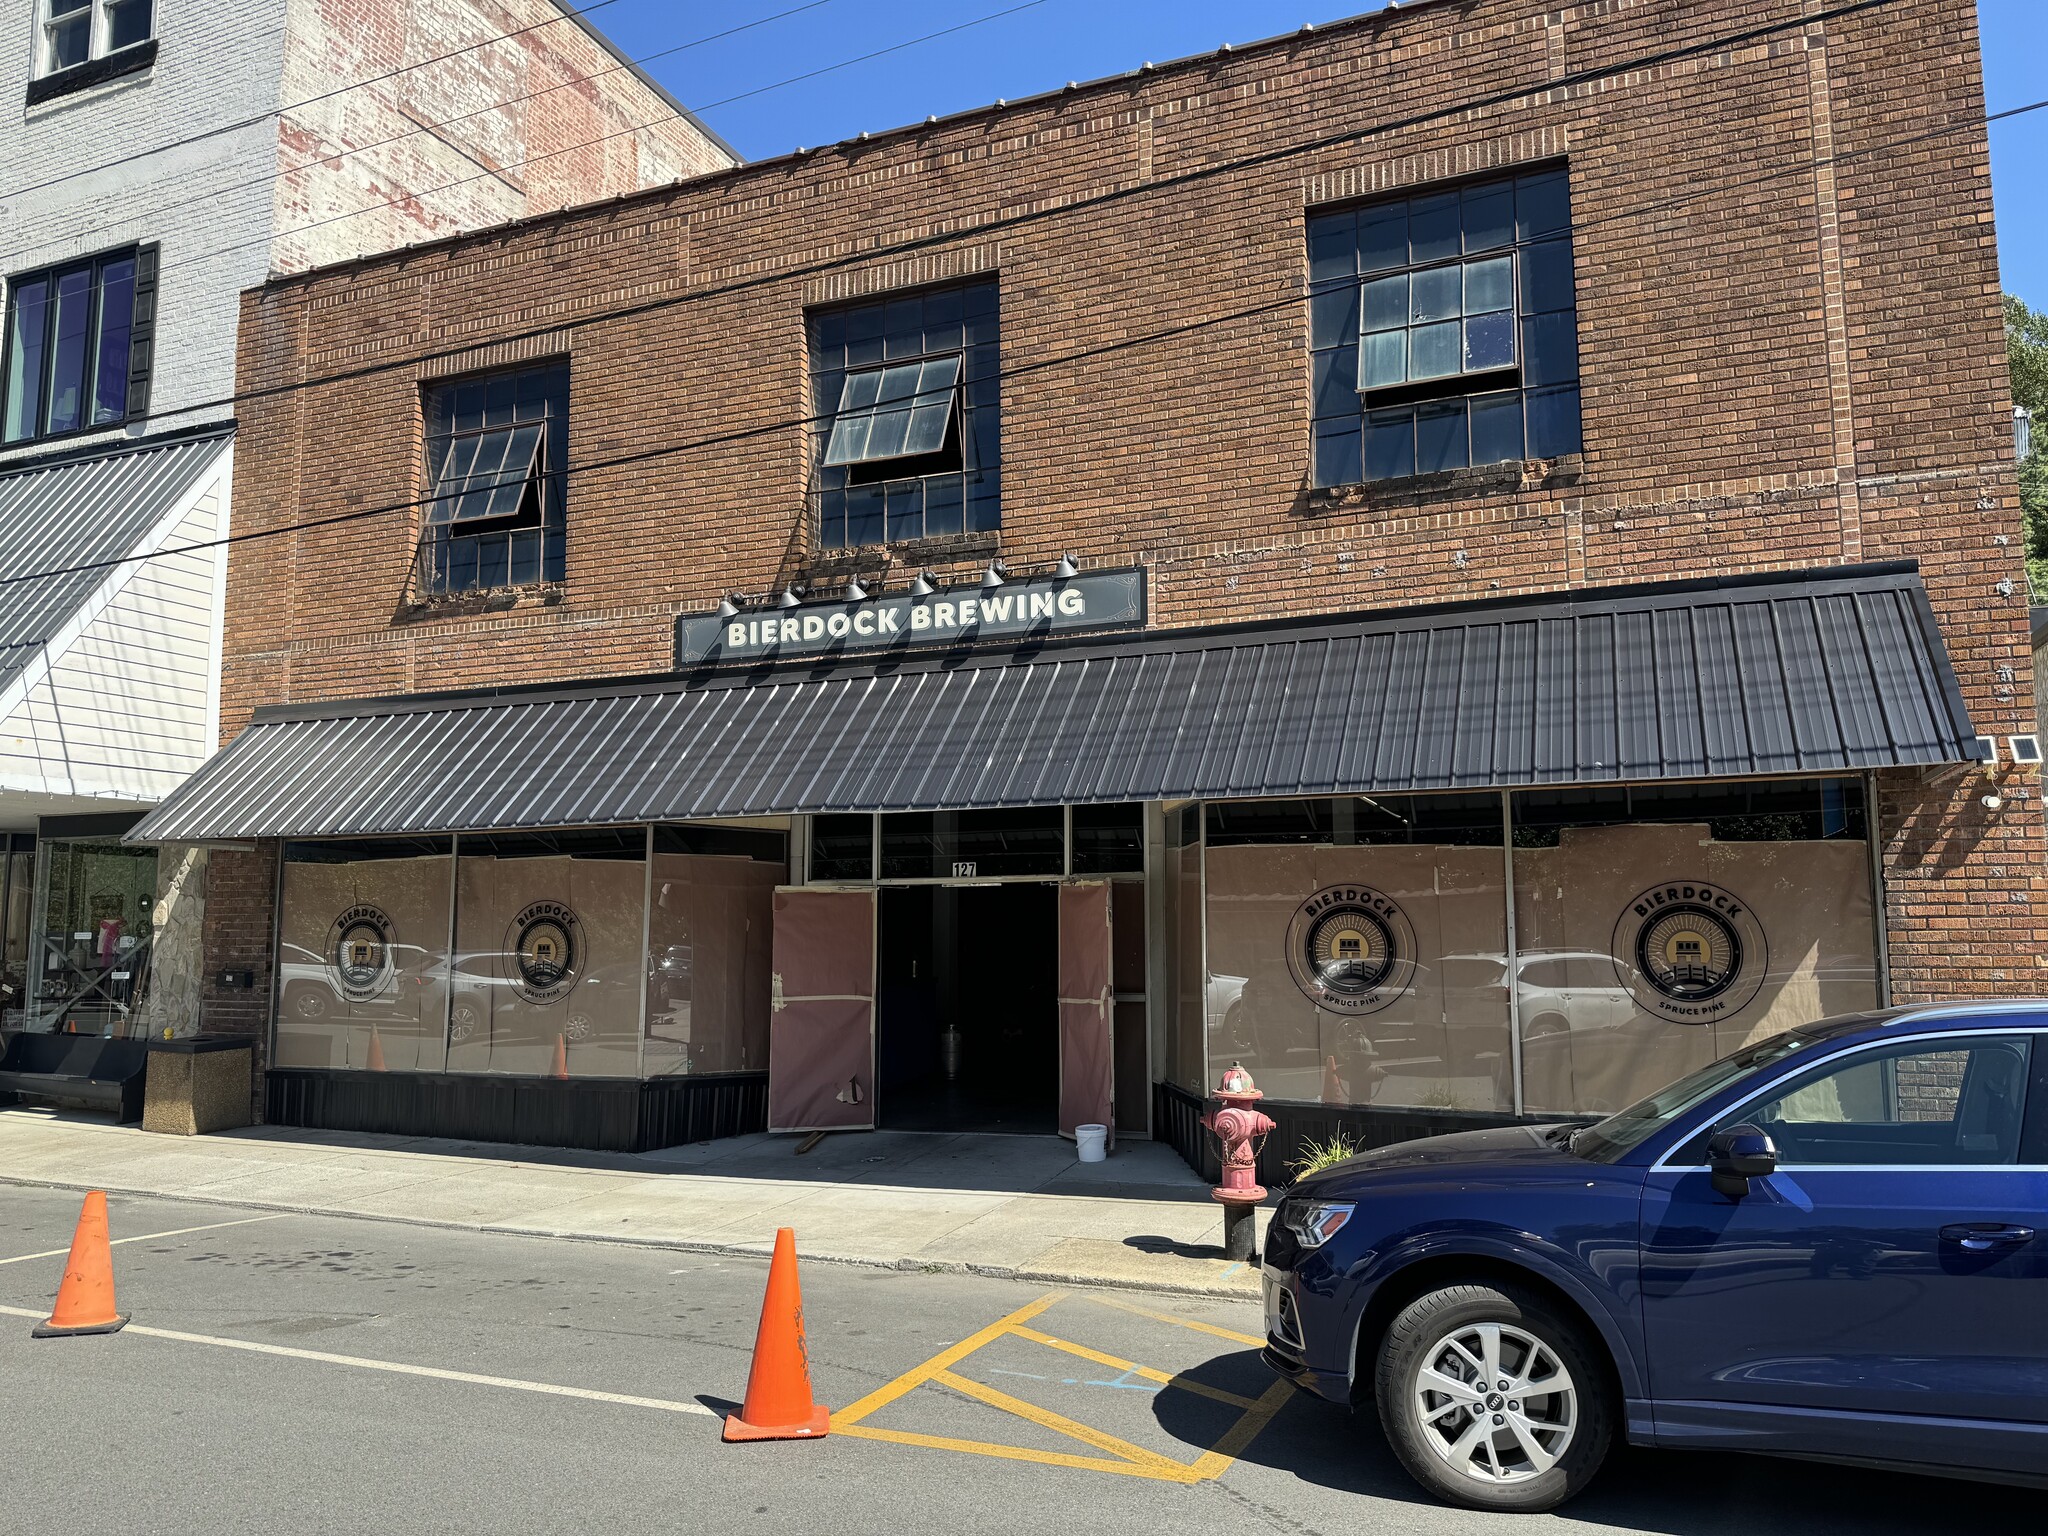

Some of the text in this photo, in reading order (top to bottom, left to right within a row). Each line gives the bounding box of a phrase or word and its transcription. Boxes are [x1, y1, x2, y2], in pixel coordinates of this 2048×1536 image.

[728, 588, 1086, 647] BIERDOCK BREWING
[954, 863, 975, 877] 127
[1305, 889, 1397, 919] BIERDOCK
[1634, 886, 1742, 919] BIERDOCK
[337, 908, 390, 930] BIERDOCK
[517, 904, 576, 928] BIERDOCK
[524, 987, 560, 998] SPRUCE PINE
[1323, 994, 1381, 1007] SPRUCE PINE
[1658, 1001, 1726, 1015] SPRUCE PINE
